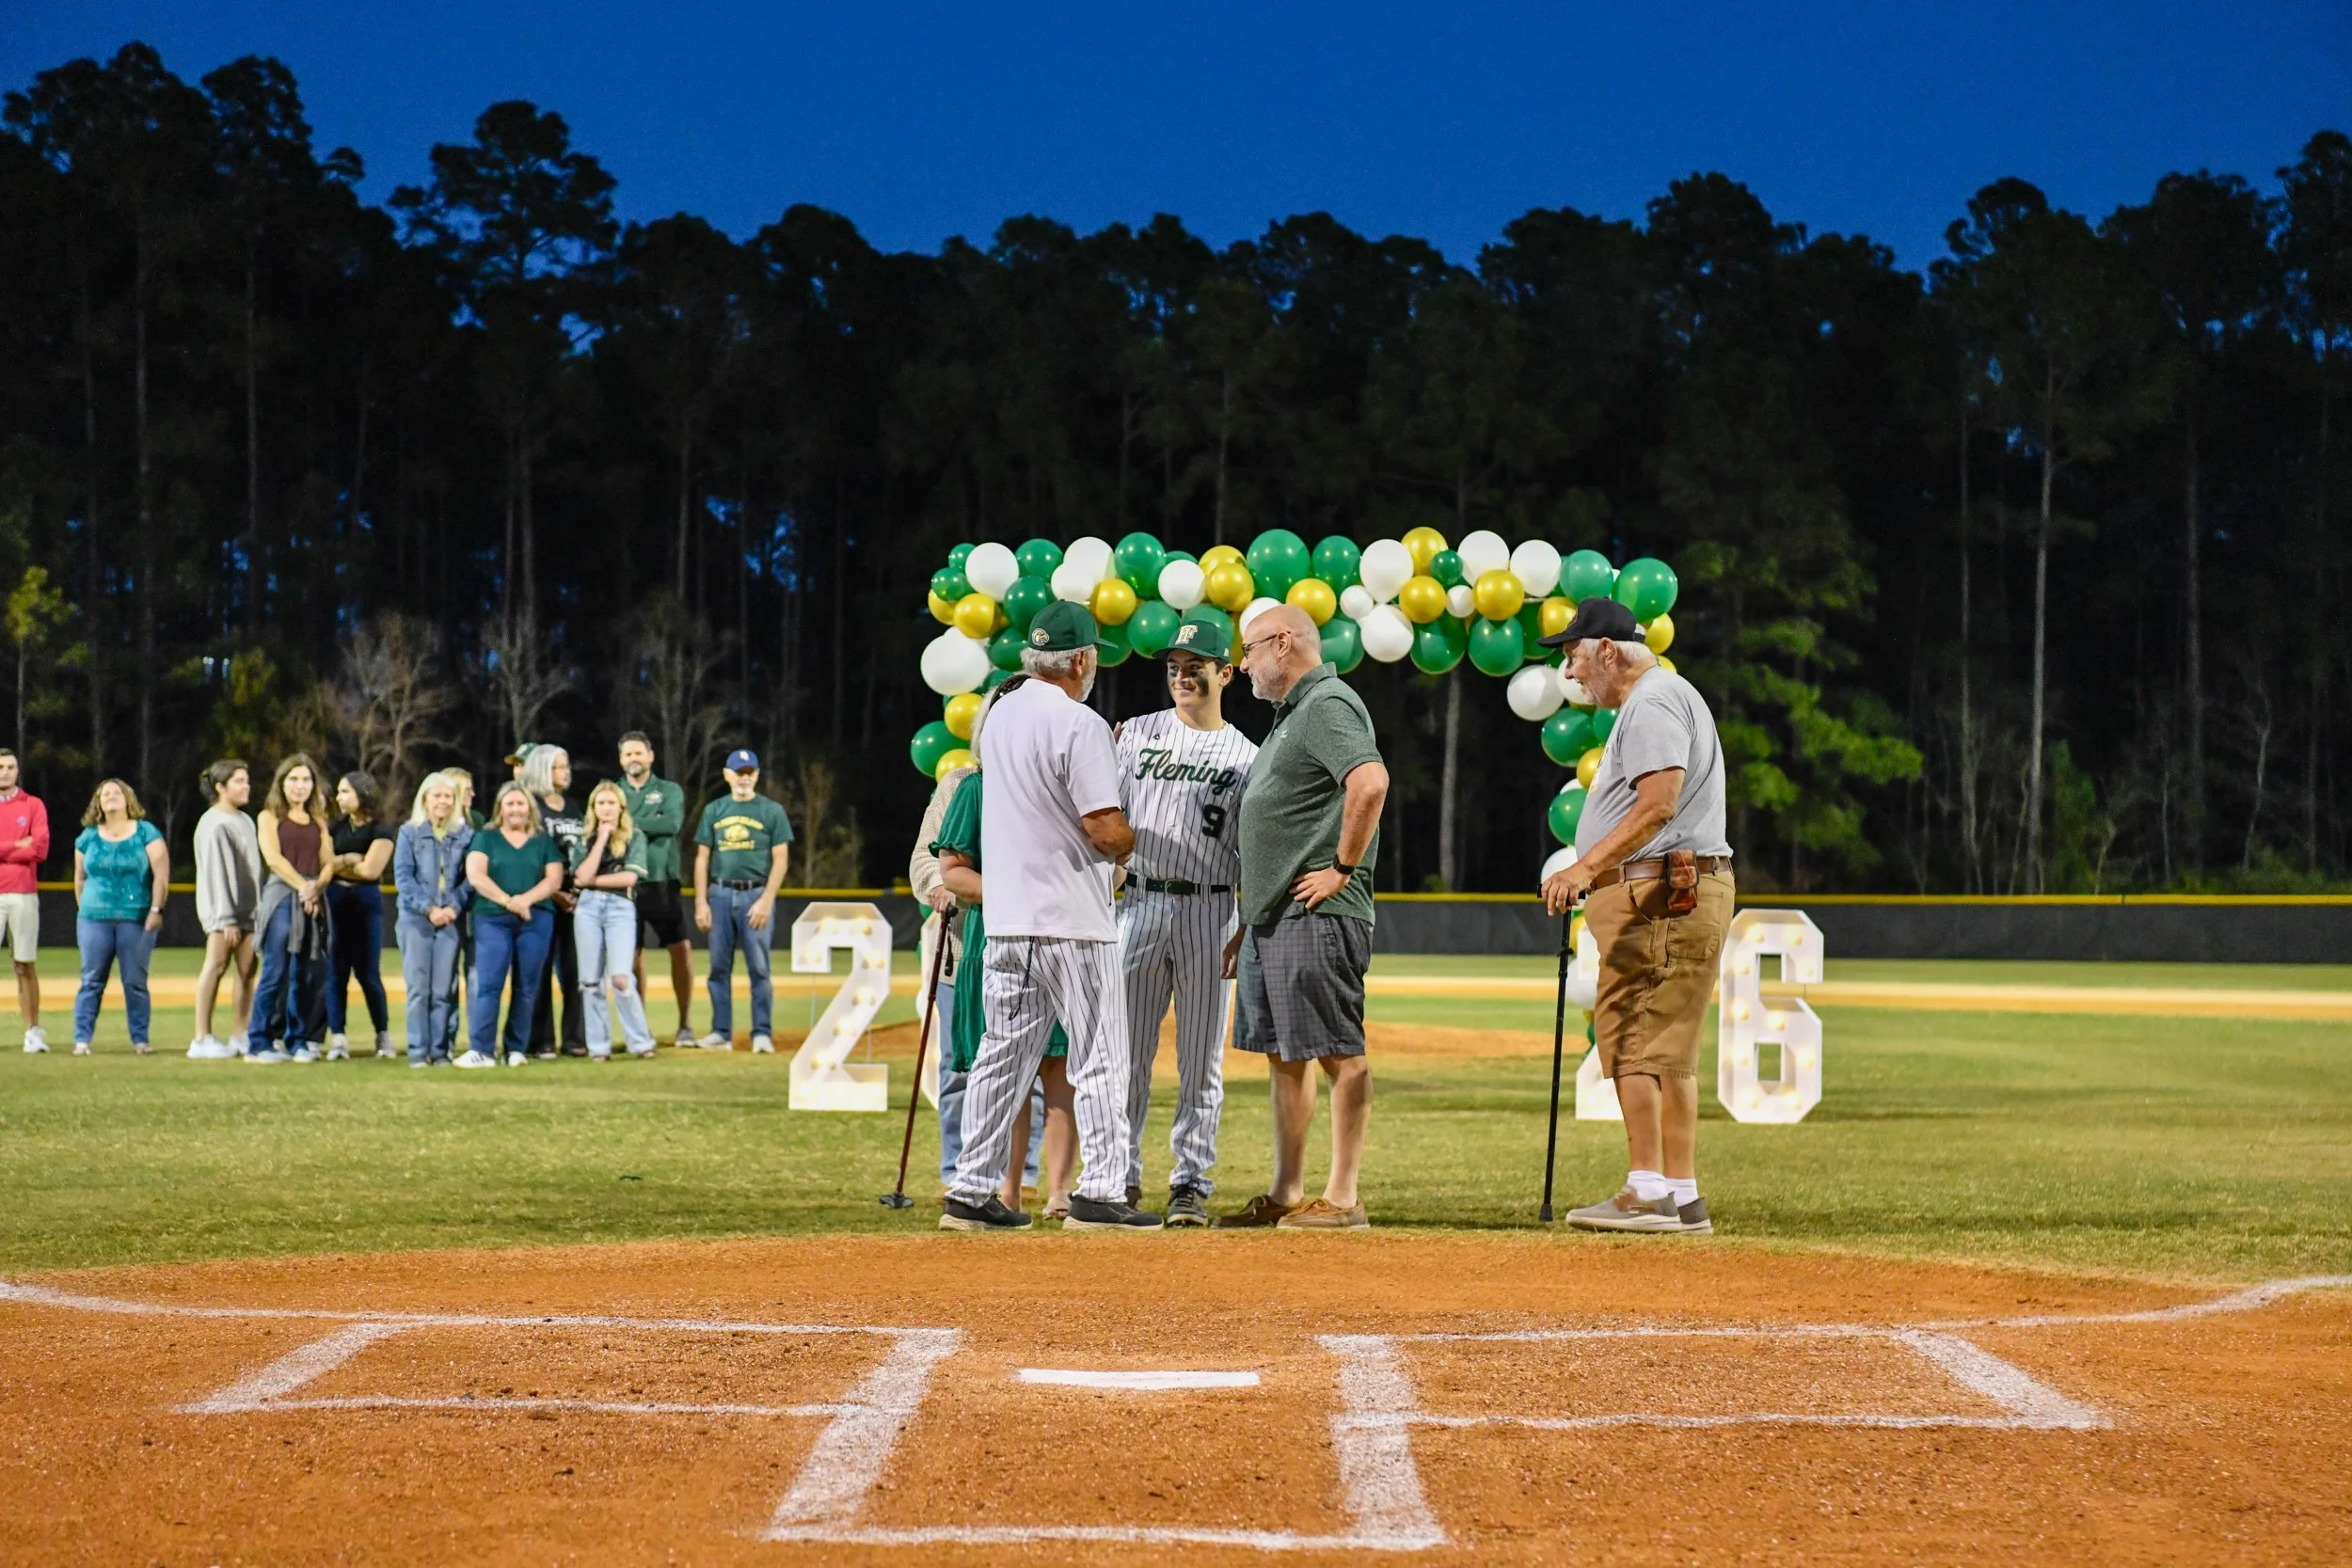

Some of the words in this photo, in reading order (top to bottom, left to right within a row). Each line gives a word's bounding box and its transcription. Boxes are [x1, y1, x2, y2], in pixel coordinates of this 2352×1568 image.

[1136, 748, 1236, 795] Fleming
[1202, 803, 1226, 838] 9
[788, 902, 893, 1111] 2
[1717, 908, 1824, 1123] 6
